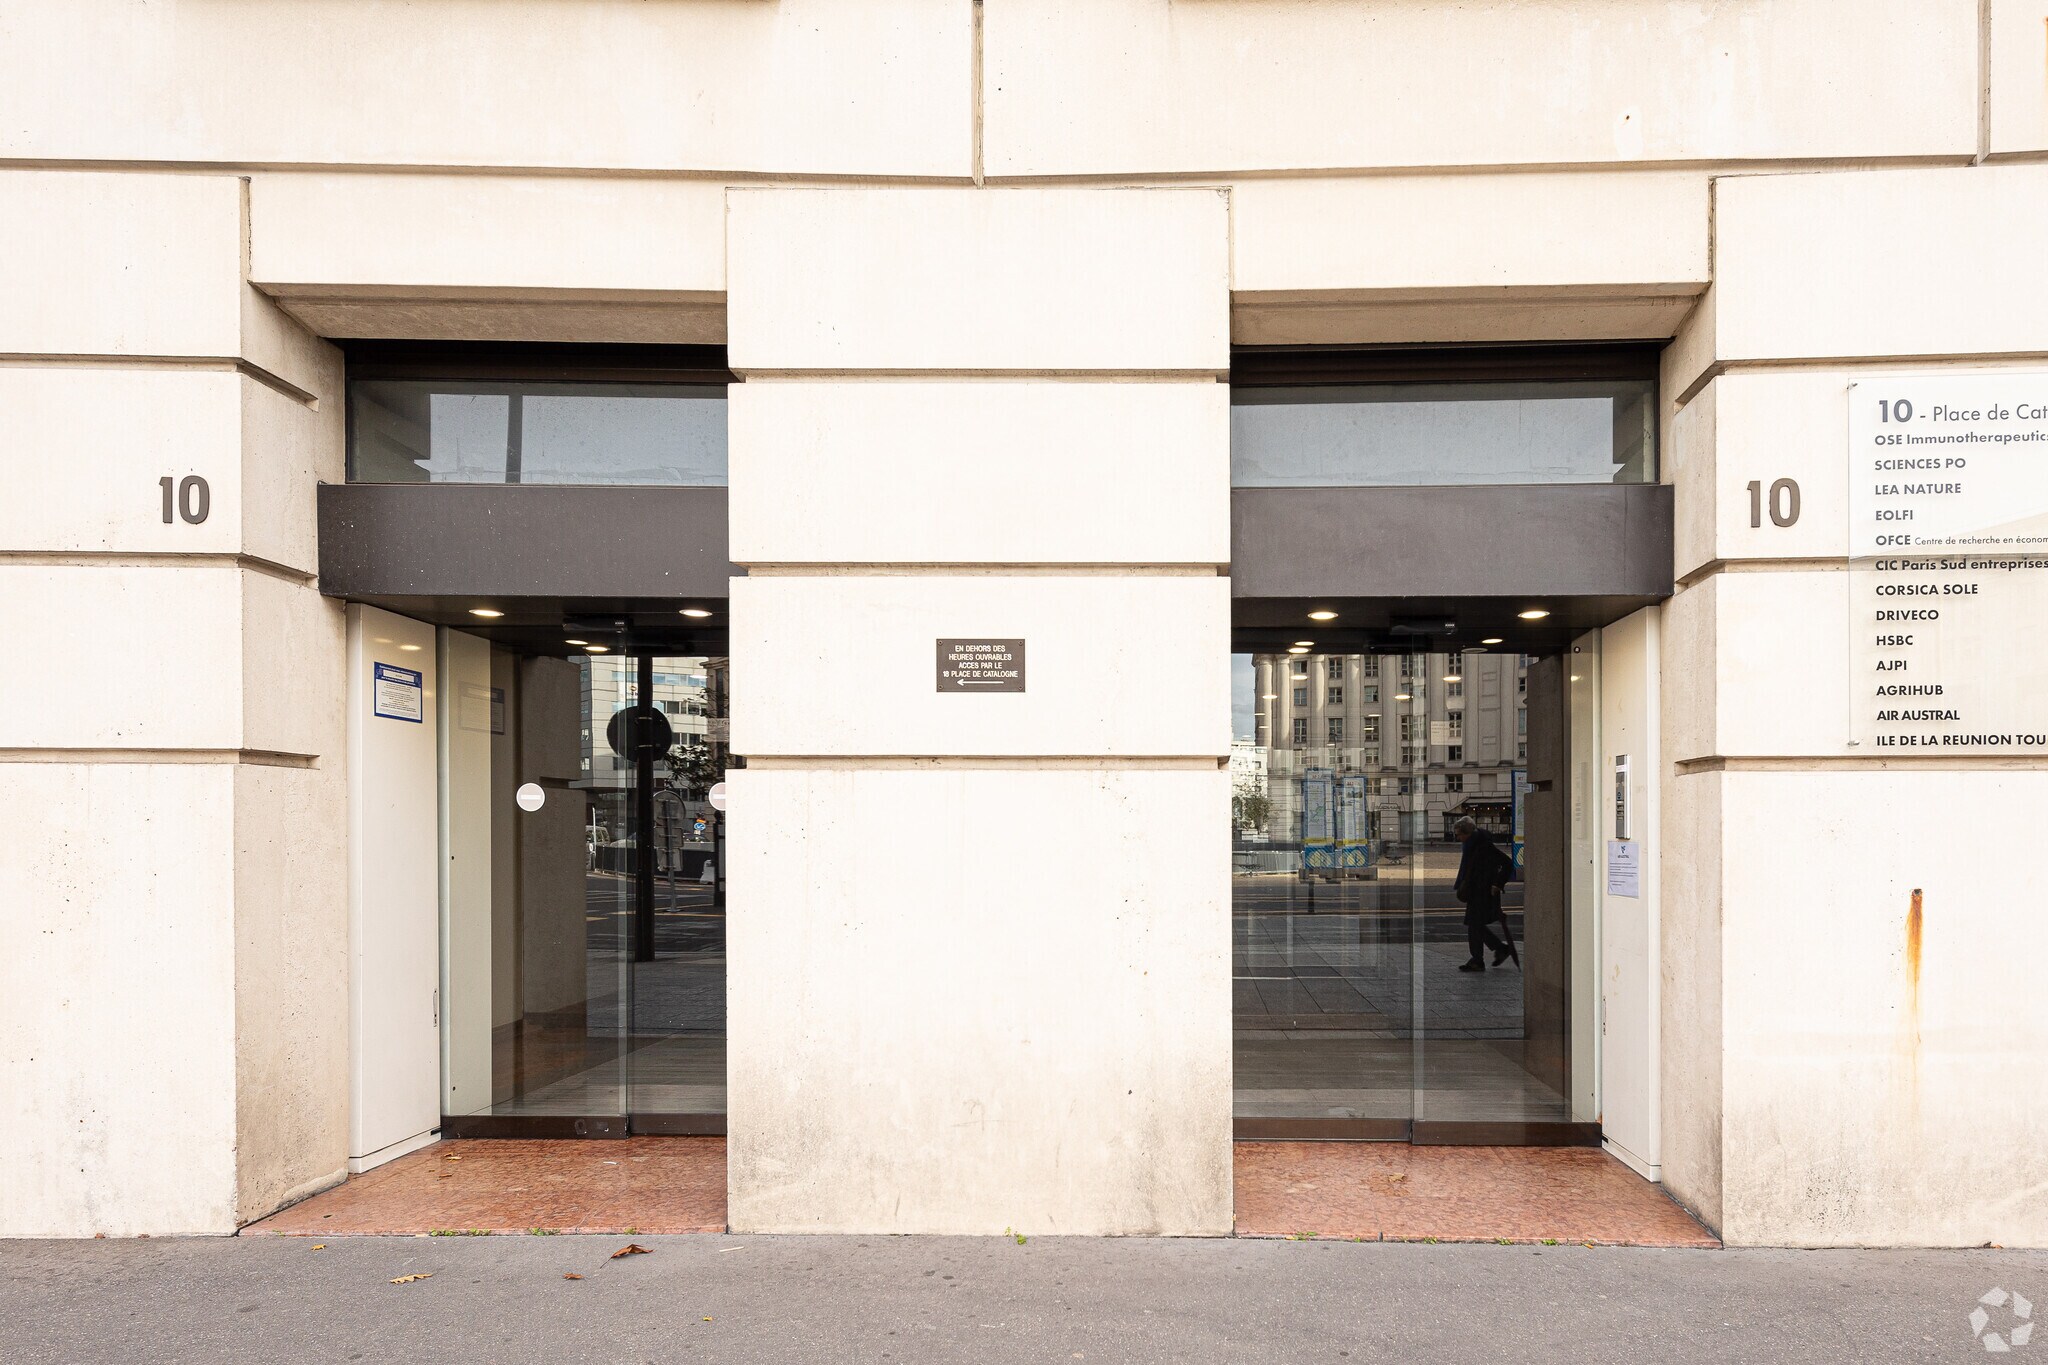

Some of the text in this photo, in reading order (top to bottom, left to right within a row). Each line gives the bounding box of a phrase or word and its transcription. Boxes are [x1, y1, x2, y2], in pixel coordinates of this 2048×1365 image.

[1879, 399, 1913, 423] 10
[1933, 404, 1981, 422] Place
[1987, 403, 2010, 421] de
[2016, 403, 2048, 420] Cat
[1874, 430, 2048, 446] OSE Immunotherapeutic
[1874, 458, 1966, 471] SCIENCES PO
[1875, 483, 1962, 495] LEA NATURE
[159, 475, 210, 524] 10
[1746, 478, 1801, 528] 10
[1875, 510, 1914, 521] EOLFI
[1875, 535, 1911, 546] OFCE
[1914, 537, 1943, 546] Centre
[1945, 536, 1957, 545] de
[1958, 536, 2001, 545] recherche
[1875, 560, 1898, 571] CIC
[1901, 559, 1937, 570] Paris
[1940, 558, 1967, 570] Sud
[1875, 584, 1978, 596] CORSICA SOLE
[1876, 609, 1939, 621] DRIVECO
[1876, 635, 1914, 646] HSBC
[955, 645, 1006, 653] EN DEHORS DES
[948, 653, 1012, 661] HEURES OUVRABLES
[1876, 660, 1907, 671] AJPI
[951, 670, 971, 678] PLACE
[972, 670, 981, 678] DE
[983, 670, 1018, 678] CATALOGNE
[1876, 685, 1944, 696] AGRIHUB
[1877, 710, 1960, 721] AIR AUSTRAL
[1876, 734, 2047, 746] ILE DE LA REUNION TOU
